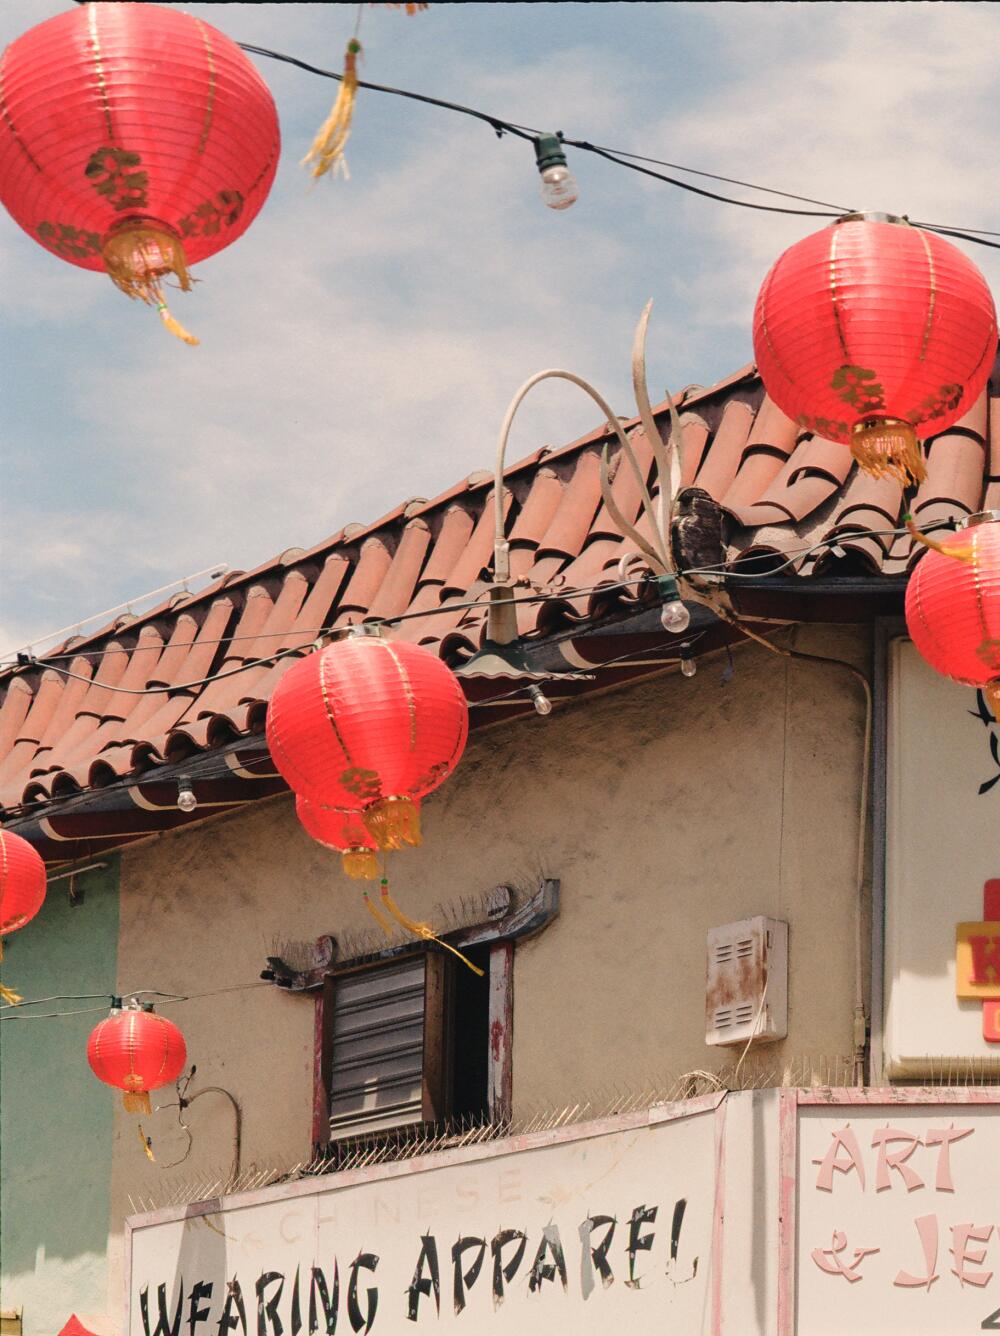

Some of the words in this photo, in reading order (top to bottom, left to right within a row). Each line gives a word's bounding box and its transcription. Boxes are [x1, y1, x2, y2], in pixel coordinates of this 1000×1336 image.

[811, 1122, 975, 1194] ART
[403, 1197, 700, 1323] APPAREL
[811, 1229, 881, 1283] &
